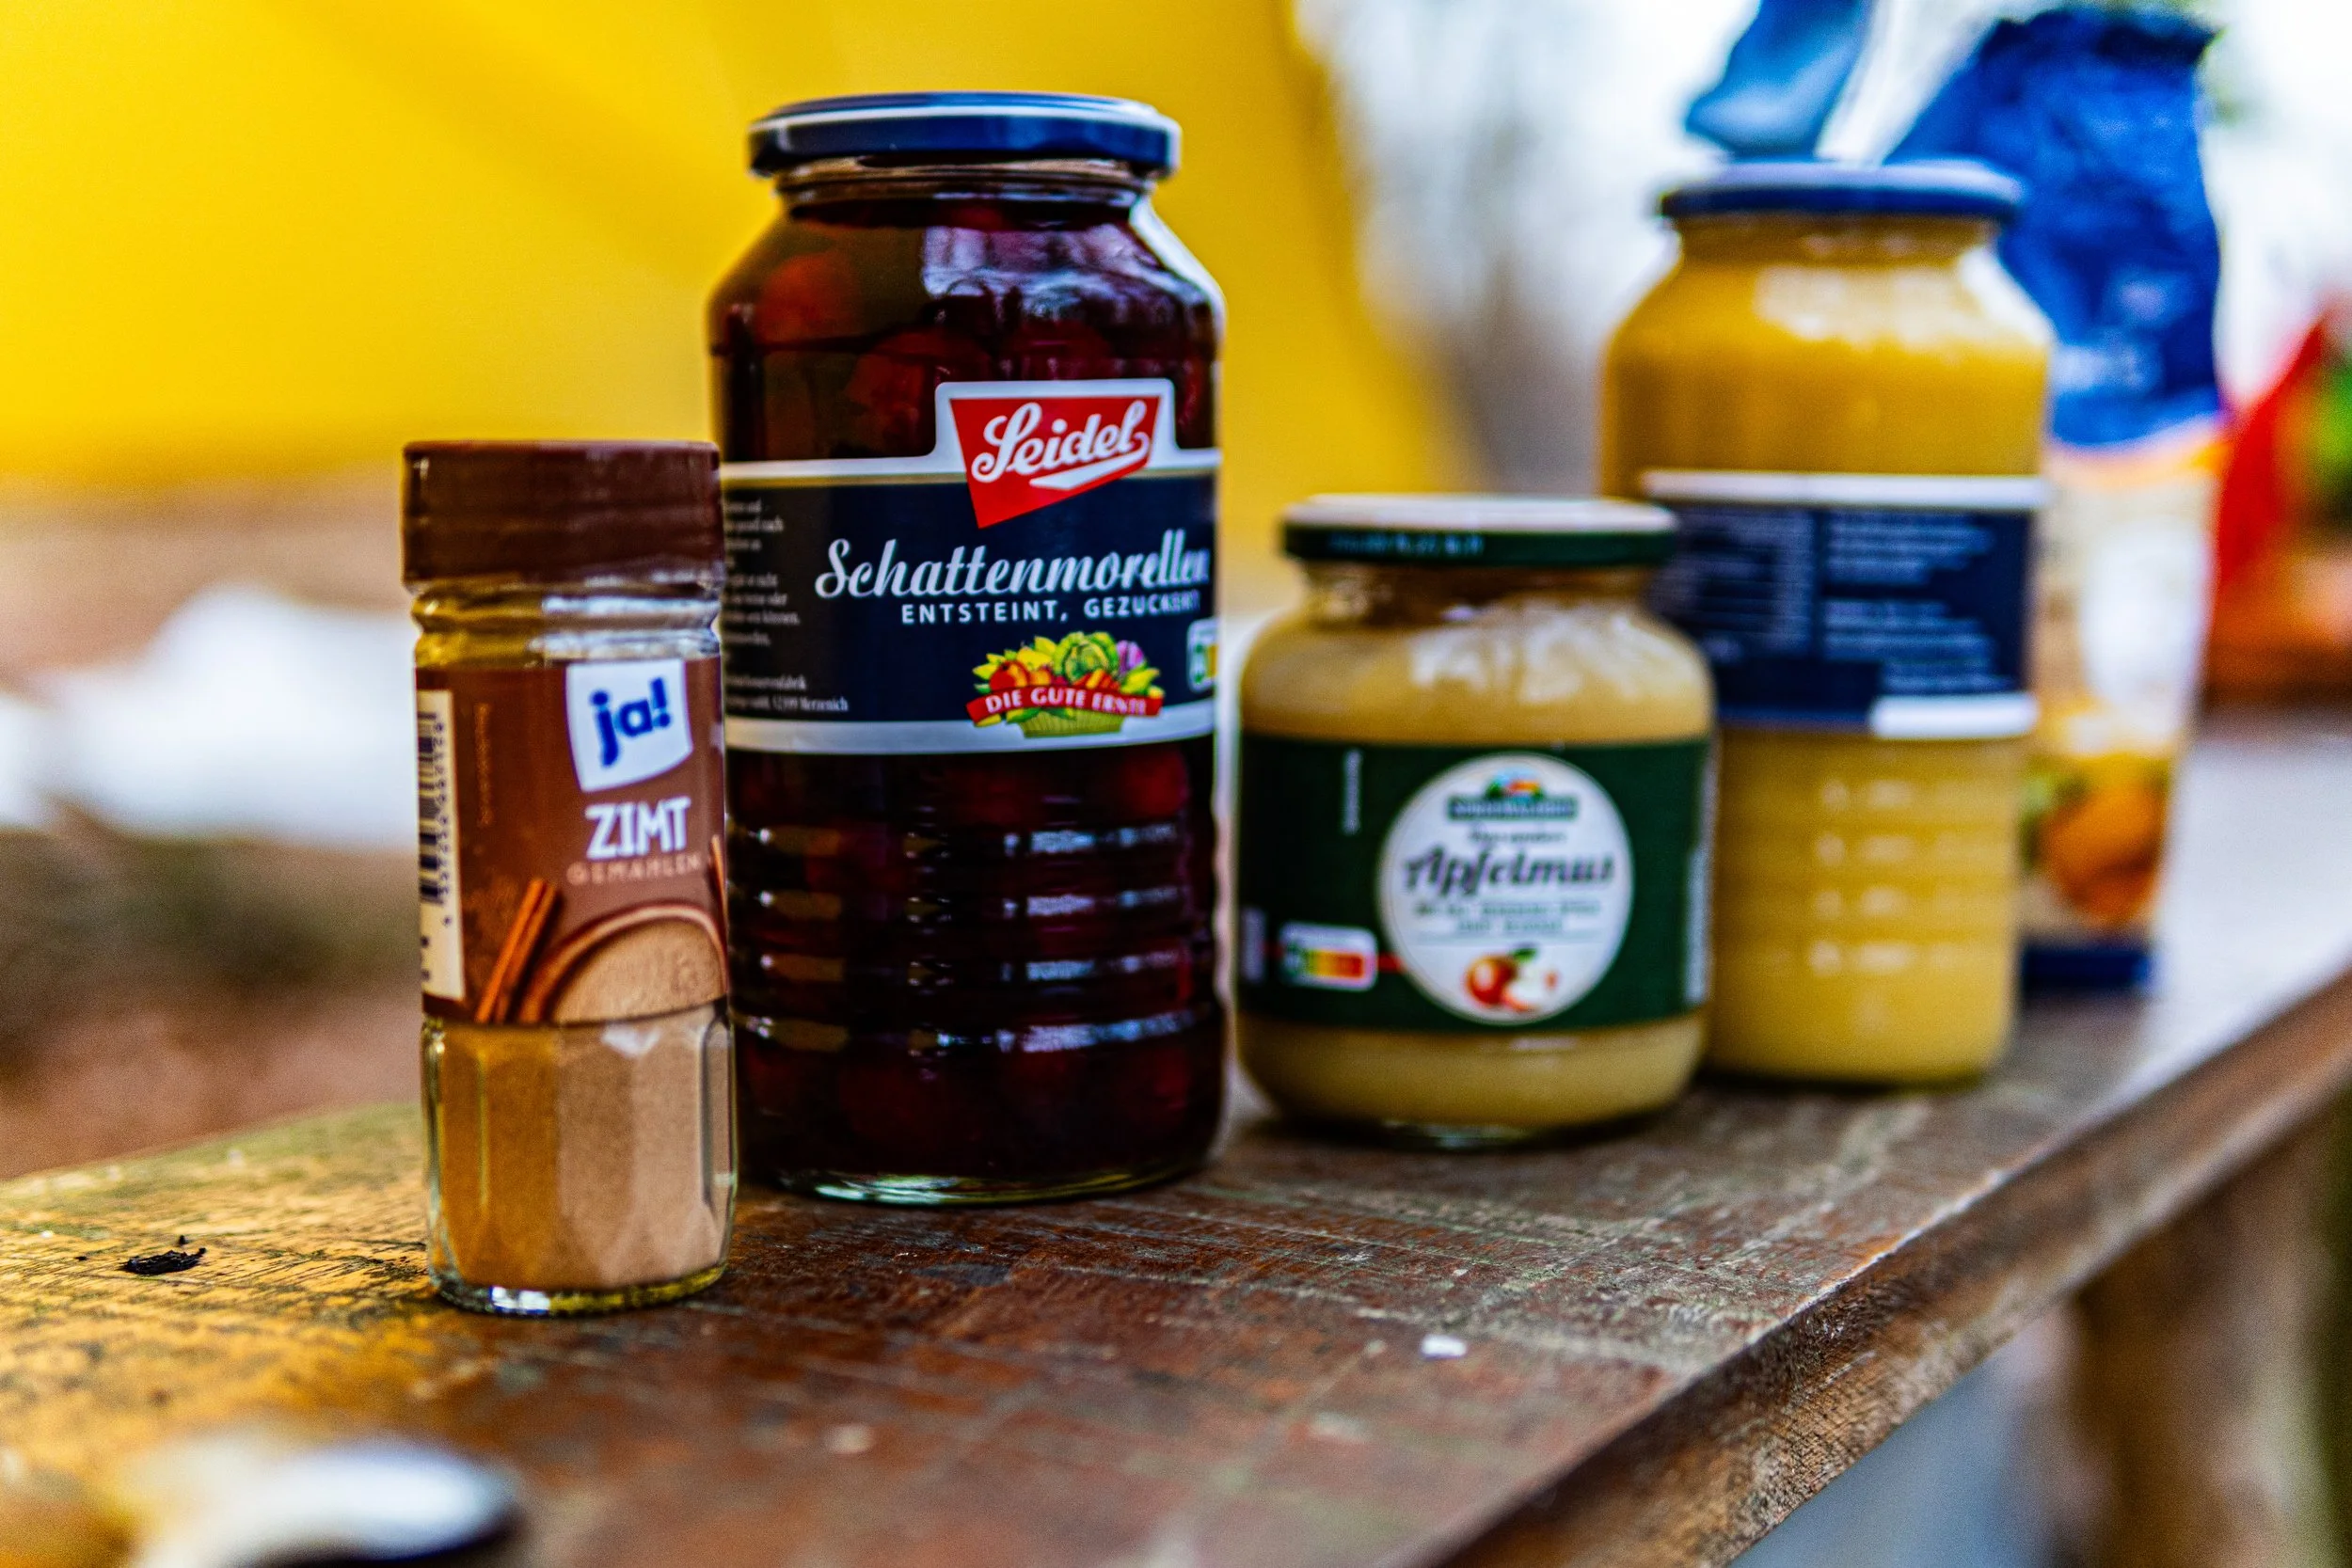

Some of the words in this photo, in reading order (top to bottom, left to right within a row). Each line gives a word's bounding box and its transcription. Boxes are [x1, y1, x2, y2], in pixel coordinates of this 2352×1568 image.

[971, 400, 1150, 483] Seidel
[901, 599, 1069, 625] ENTSTEINT,
[589, 676, 672, 768] ja!
[985, 689, 1023, 714] DIE
[1030, 687, 1086, 706] GUTE
[584, 796, 691, 861] ZIMT
[1405, 845, 1614, 897] Apfelmus
